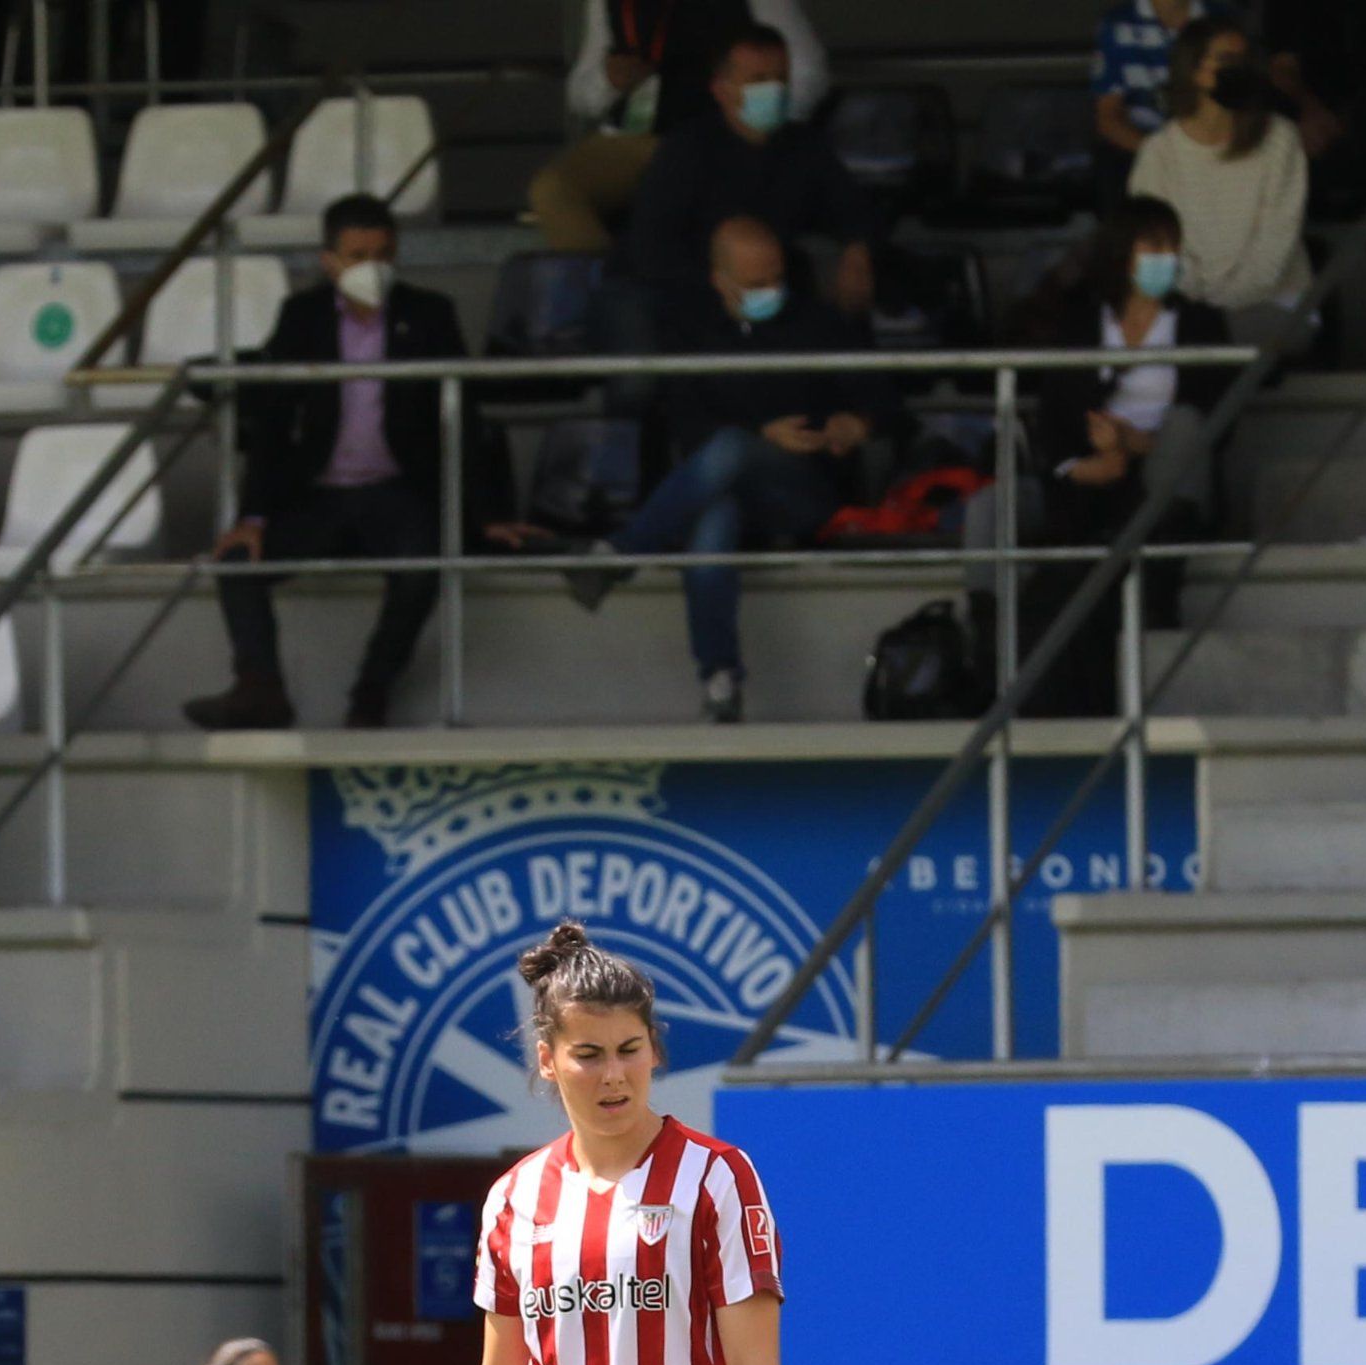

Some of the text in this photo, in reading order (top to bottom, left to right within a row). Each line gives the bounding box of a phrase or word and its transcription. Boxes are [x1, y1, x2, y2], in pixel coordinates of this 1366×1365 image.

[321, 850, 798, 1131] REAL CLUB DEPORTIVO
[524, 1272, 672, 1319] euskaltel
